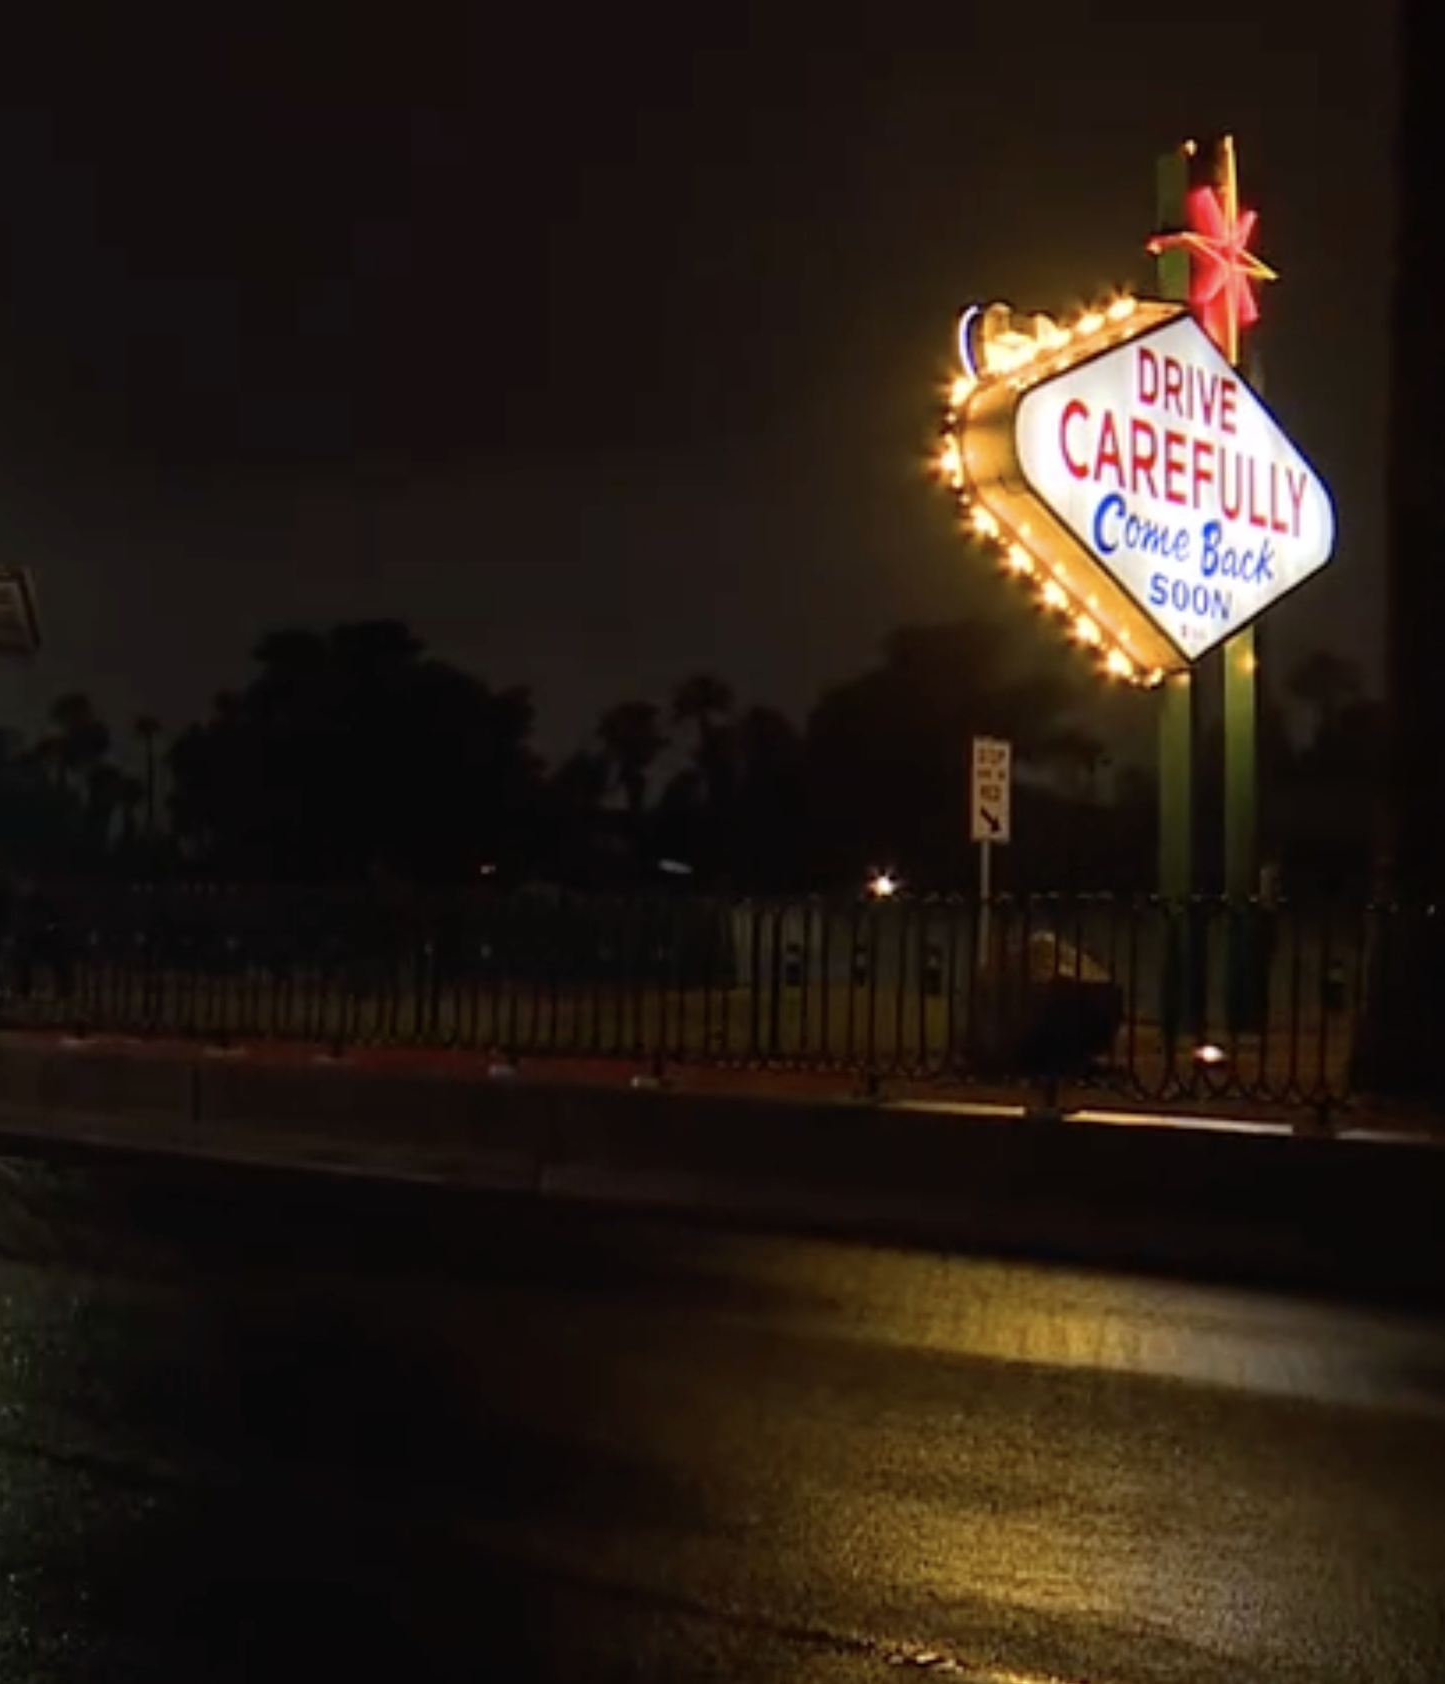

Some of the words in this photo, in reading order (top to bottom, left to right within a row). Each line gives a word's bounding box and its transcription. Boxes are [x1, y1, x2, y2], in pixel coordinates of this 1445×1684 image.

[1137, 346, 1238, 435] DRIVE
[1059, 398, 1308, 538] CAREFULLY
[1092, 492, 1191, 562] Come
[1200, 519, 1276, 584] Back
[1147, 572, 1233, 620] SOON
